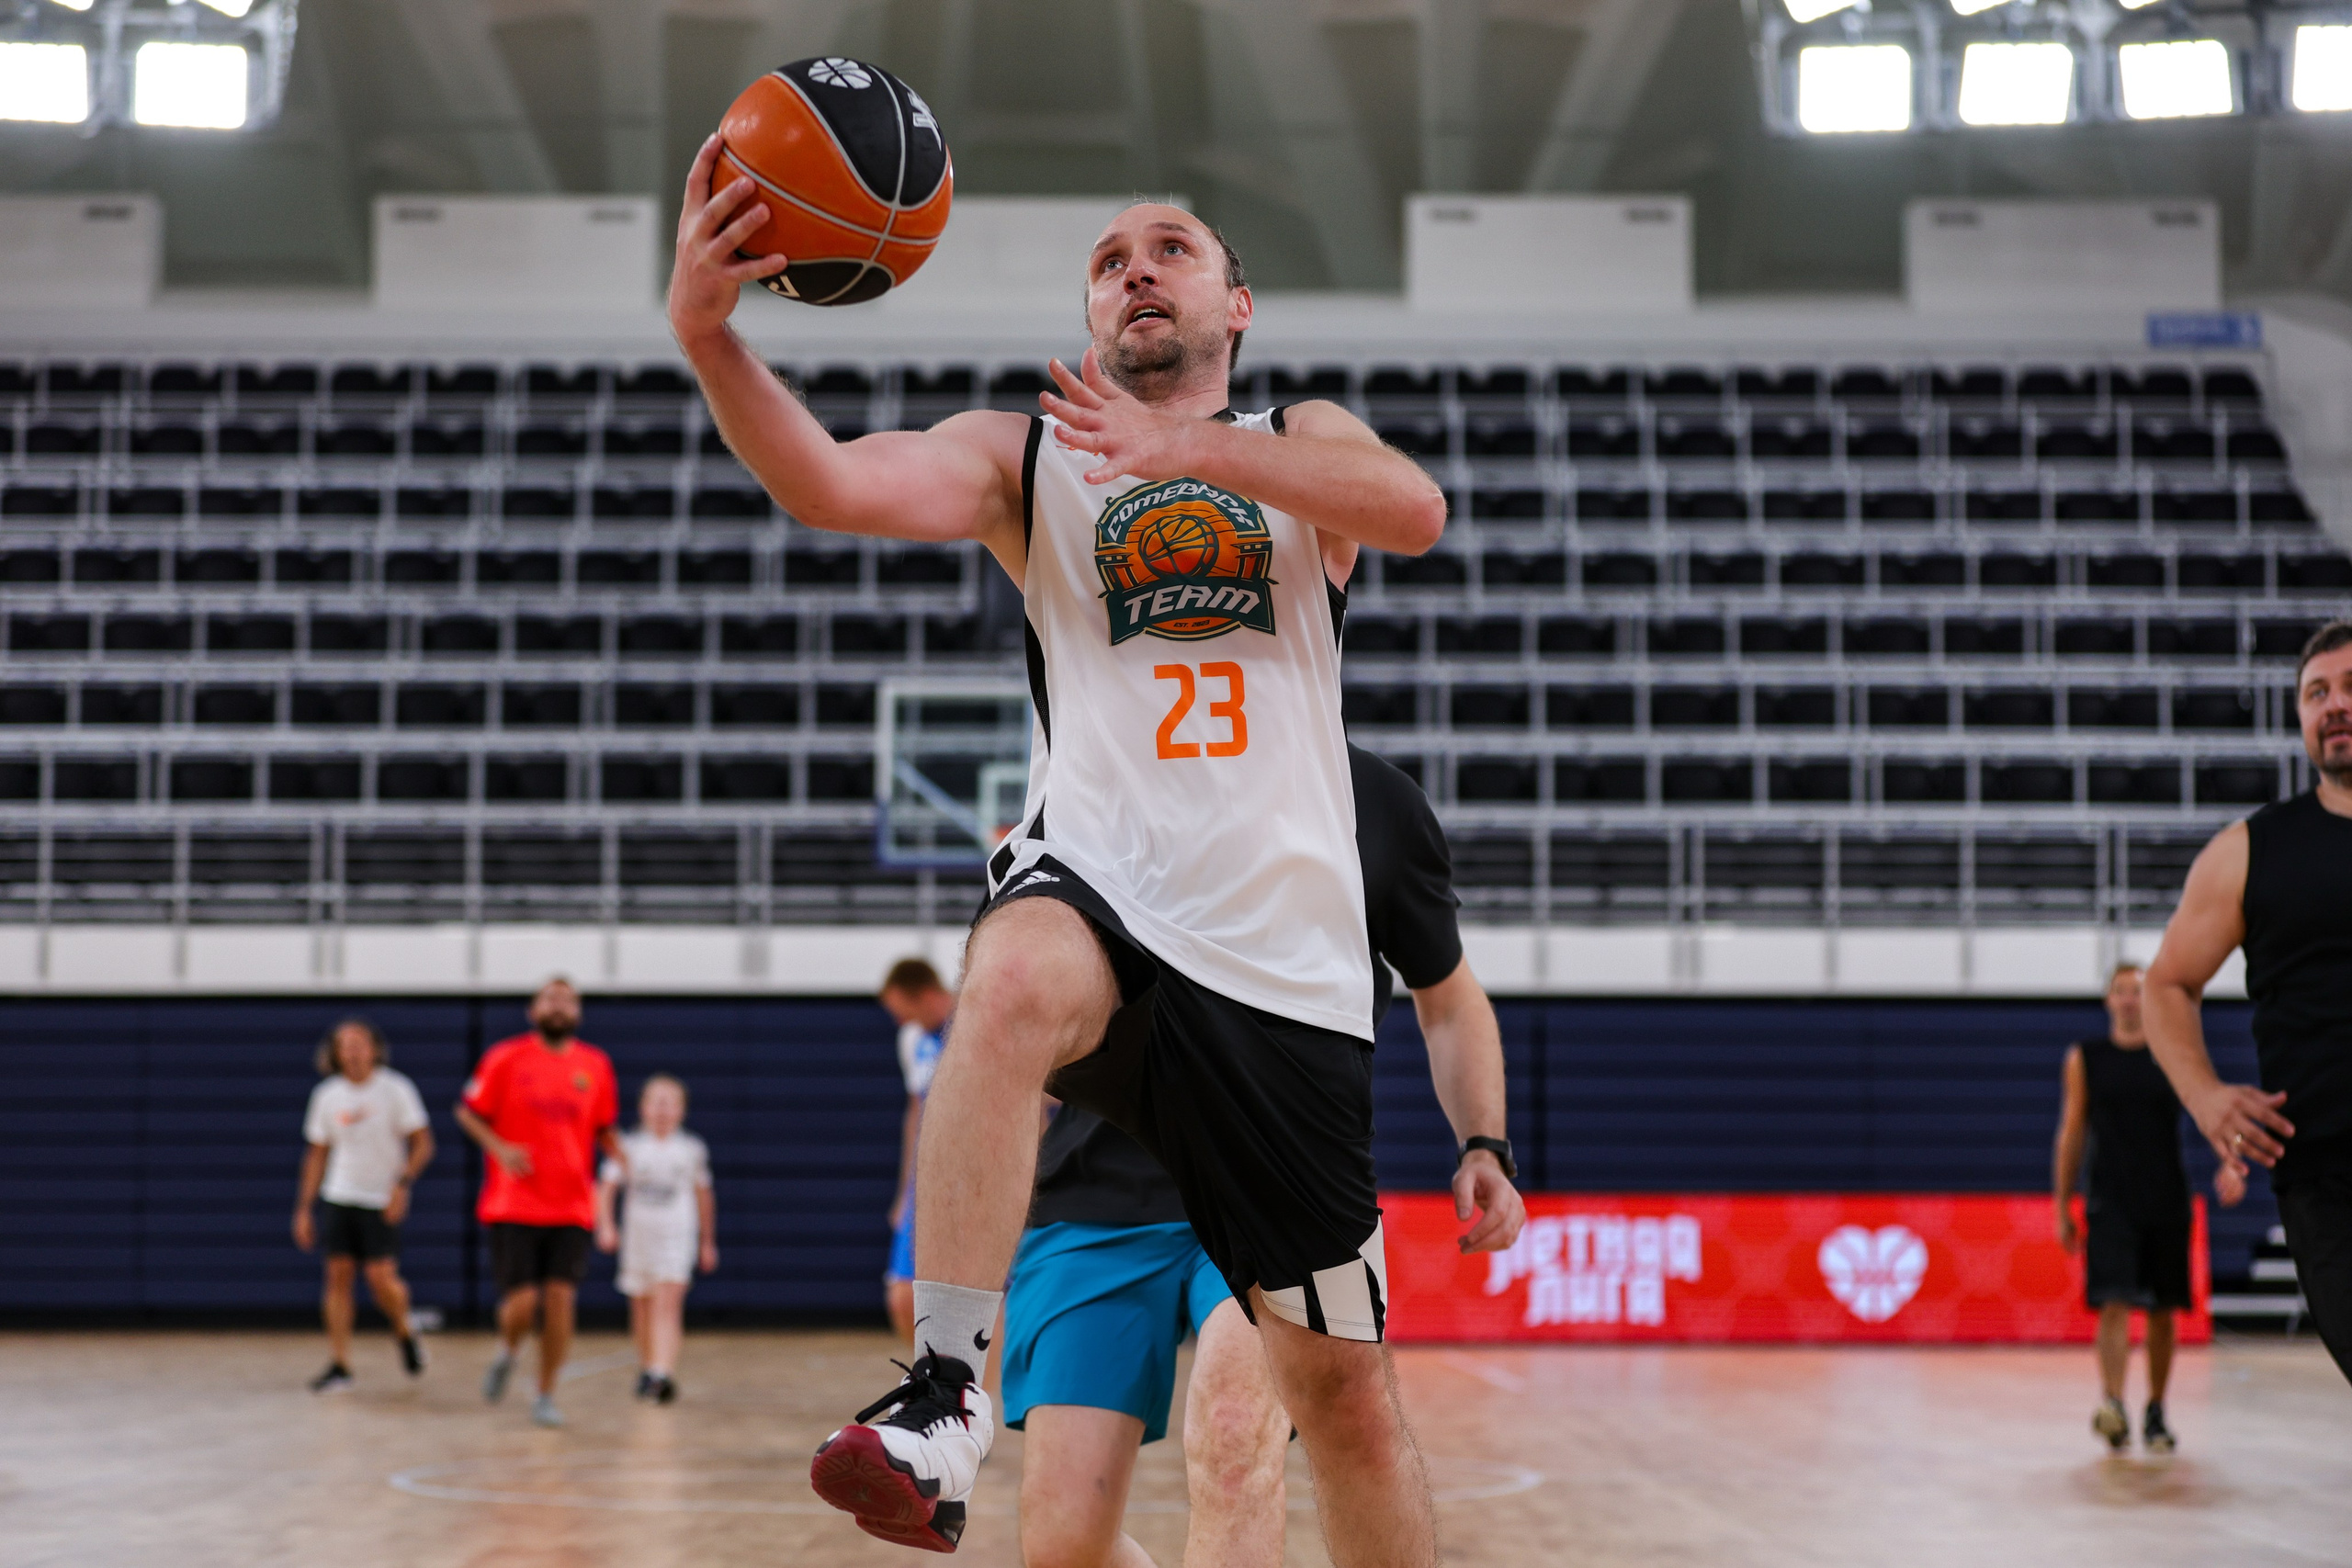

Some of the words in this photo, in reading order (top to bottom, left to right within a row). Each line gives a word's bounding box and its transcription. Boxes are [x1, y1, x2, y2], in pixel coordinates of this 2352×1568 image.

[1108, 482, 1255, 542] COMEBACK
[1124, 584, 1261, 626] TEAM
[1154, 660, 1248, 760] 23
